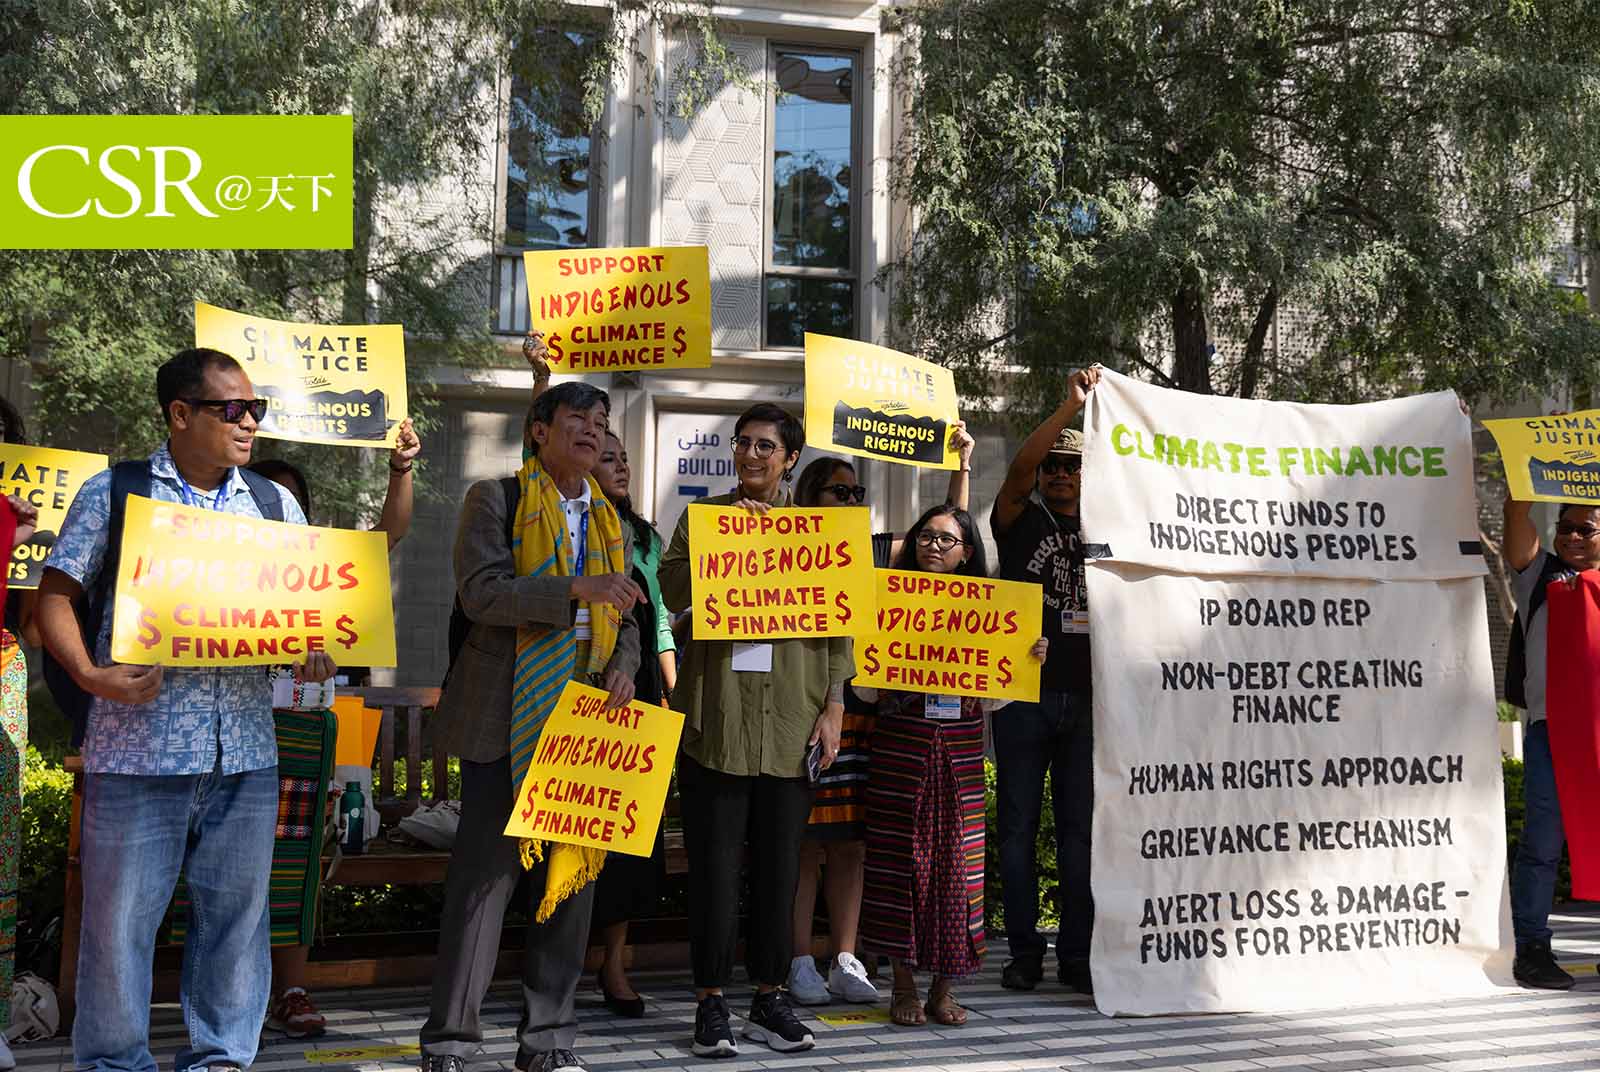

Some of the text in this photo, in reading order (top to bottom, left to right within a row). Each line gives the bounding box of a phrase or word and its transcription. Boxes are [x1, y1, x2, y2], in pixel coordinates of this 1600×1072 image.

[559, 255, 665, 276] SUPPORT
[541, 278, 690, 320] INDIGENOUS
[244, 326, 368, 353] CMATE
[547, 332, 564, 364] $
[570, 322, 665, 344] CLIMATE
[672, 325, 687, 358] $
[246, 346, 368, 372] JUTICE
[569, 346, 665, 368] FINANCE
[678, 428, 720, 451] مبنى
[847, 416, 935, 442] INDIGENOUS
[864, 435, 915, 455] RIGHTS
[1111, 423, 1448, 477] CLIMATE FINANCE
[678, 457, 736, 477] BUILDI
[718, 515, 823, 535] SUPPORT
[1175, 492, 1386, 528] DIRECT FUNDS TO
[170, 512, 321, 551] SUPPORT
[1149, 521, 1417, 561] INDIGENOUS PEOPLES
[132, 555, 359, 592] INDIGENOUS
[699, 540, 852, 580] INDIGENOUS
[726, 586, 826, 608] CLIMATE
[887, 575, 995, 600] SUPPORT
[172, 603, 322, 629] CLIMATE
[705, 593, 721, 629] $
[835, 590, 852, 625] $
[877, 607, 1018, 634] NDIGENOUS
[1200, 598, 1371, 627] IP BOARD REP
[137, 608, 162, 650] $
[335, 614, 359, 650] $
[727, 613, 828, 635] FINANCE
[171, 635, 325, 659] FINANCE
[863, 644, 881, 676] $
[888, 641, 989, 666] CLIMATE
[886, 666, 989, 692] FINANCE
[996, 656, 1012, 688] $
[1161, 659, 1423, 691] NON-DEBT CREATING
[571, 694, 644, 730] SUPPORT
[1233, 693, 1341, 725] FINANCE
[537, 734, 657, 774] INDIGENOUS
[1128, 754, 1464, 796] HUMAN RIGHTS APPROACH
[521, 781, 538, 823] $
[543, 777, 622, 812] CLIMATE
[532, 809, 616, 842] FINANCE
[621, 800, 638, 839] $
[1140, 817, 1453, 859] GRIEVANCE MECHANISM
[1139, 893, 1222, 928] AVERT
[1231, 888, 1299, 921] LOSS
[1311, 888, 1329, 917] &
[1336, 880, 1447, 915] DAMAGE
[1139, 917, 1462, 964] FUNDS FOR PREVENTION
